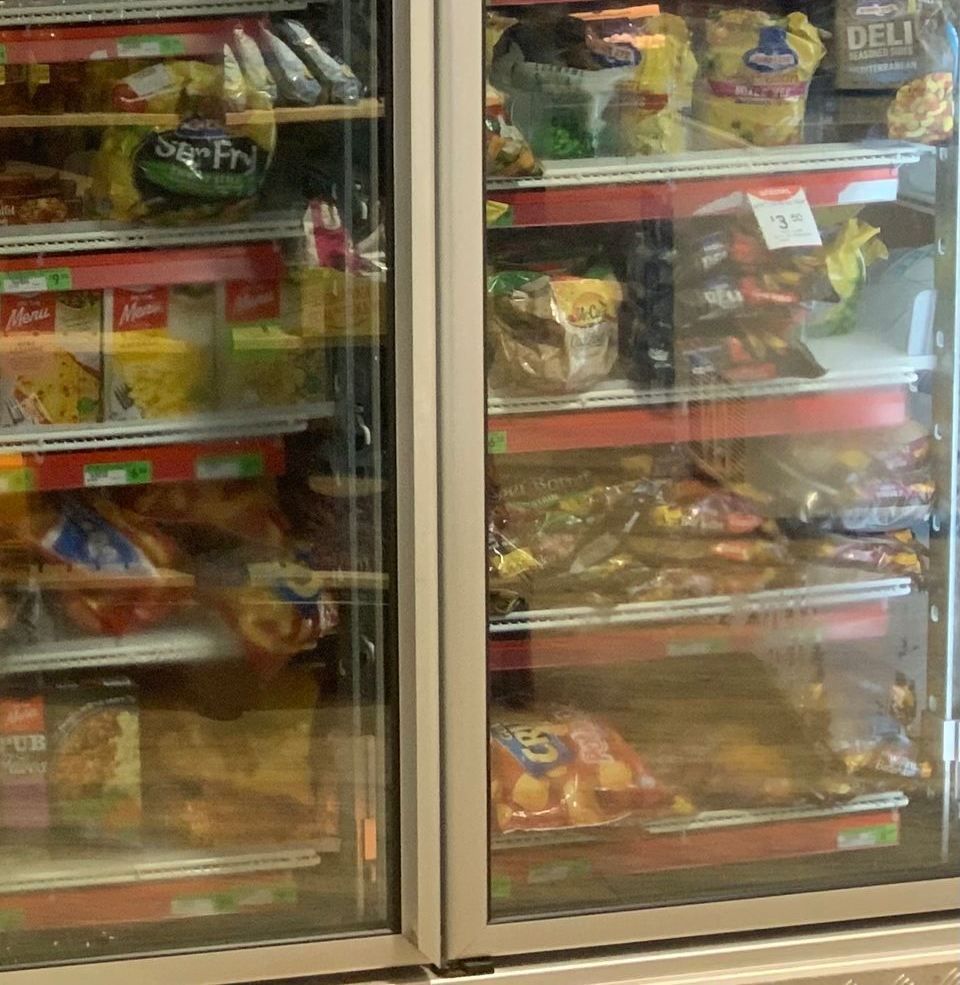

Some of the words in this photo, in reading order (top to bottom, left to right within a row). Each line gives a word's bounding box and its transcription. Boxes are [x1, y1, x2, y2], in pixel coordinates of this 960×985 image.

[847, 20, 914, 50] DELI
[213, 140, 257, 174] Fry
[6, 306, 50, 330] Menu
